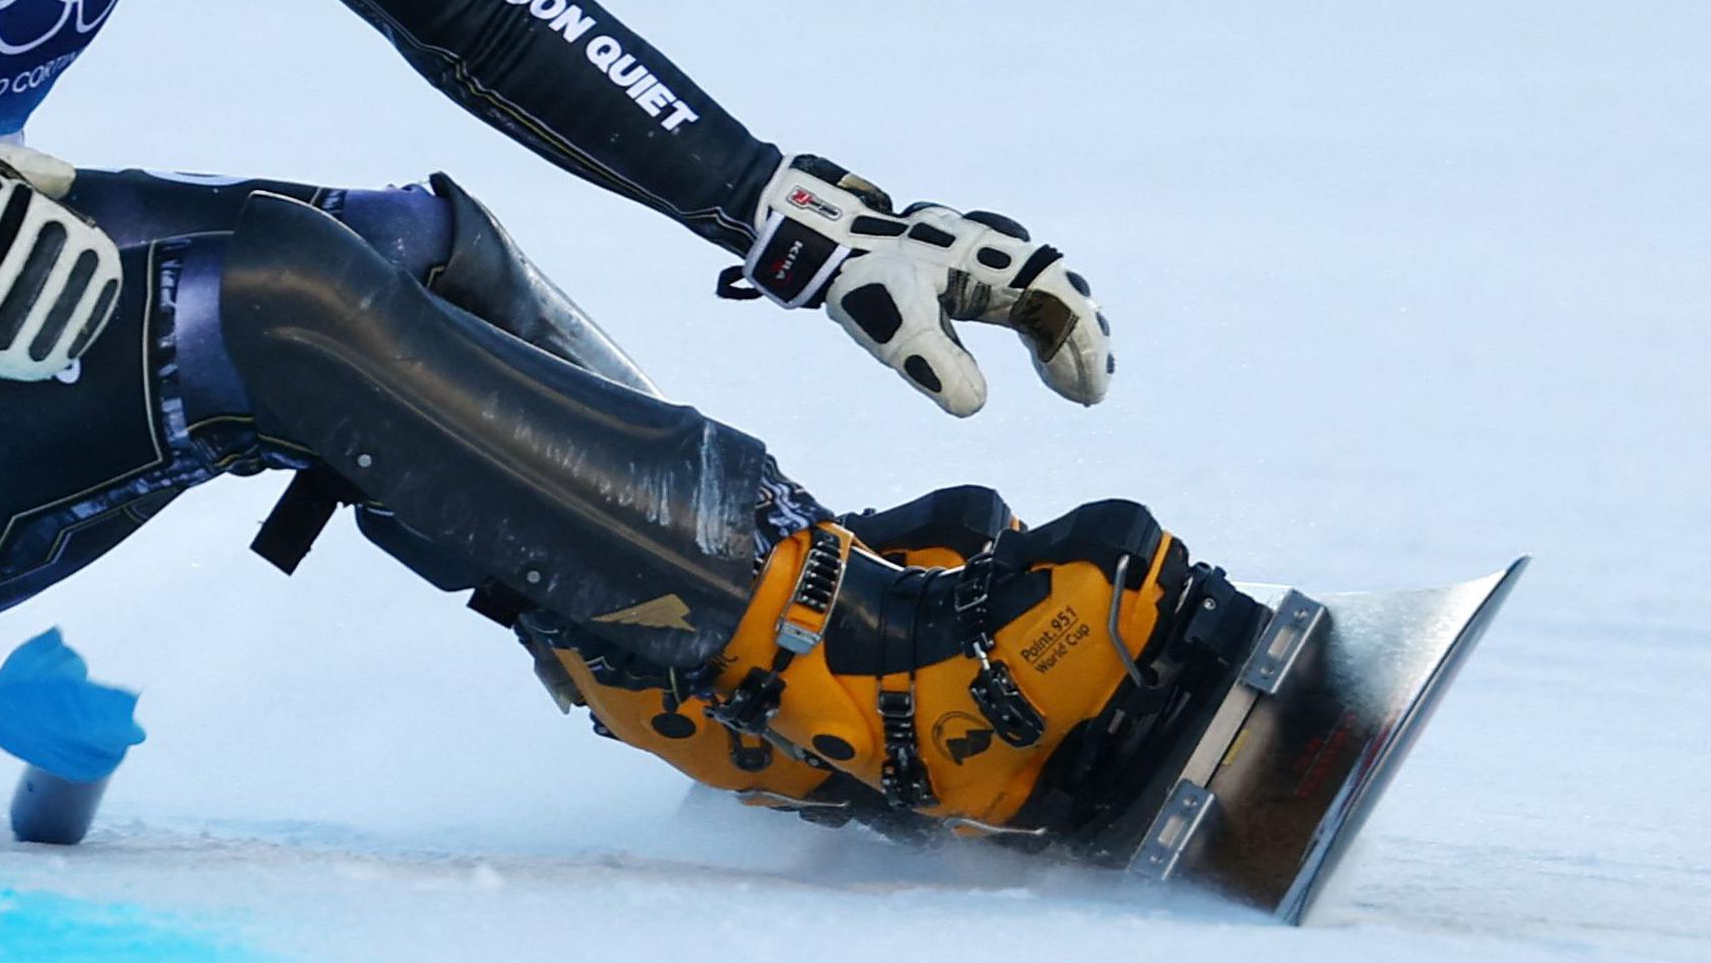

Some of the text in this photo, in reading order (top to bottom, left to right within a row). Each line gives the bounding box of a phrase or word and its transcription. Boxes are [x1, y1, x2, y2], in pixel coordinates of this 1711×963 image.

[584, 33, 700, 134] QUIET
[1034, 623, 1090, 674] World Cup
